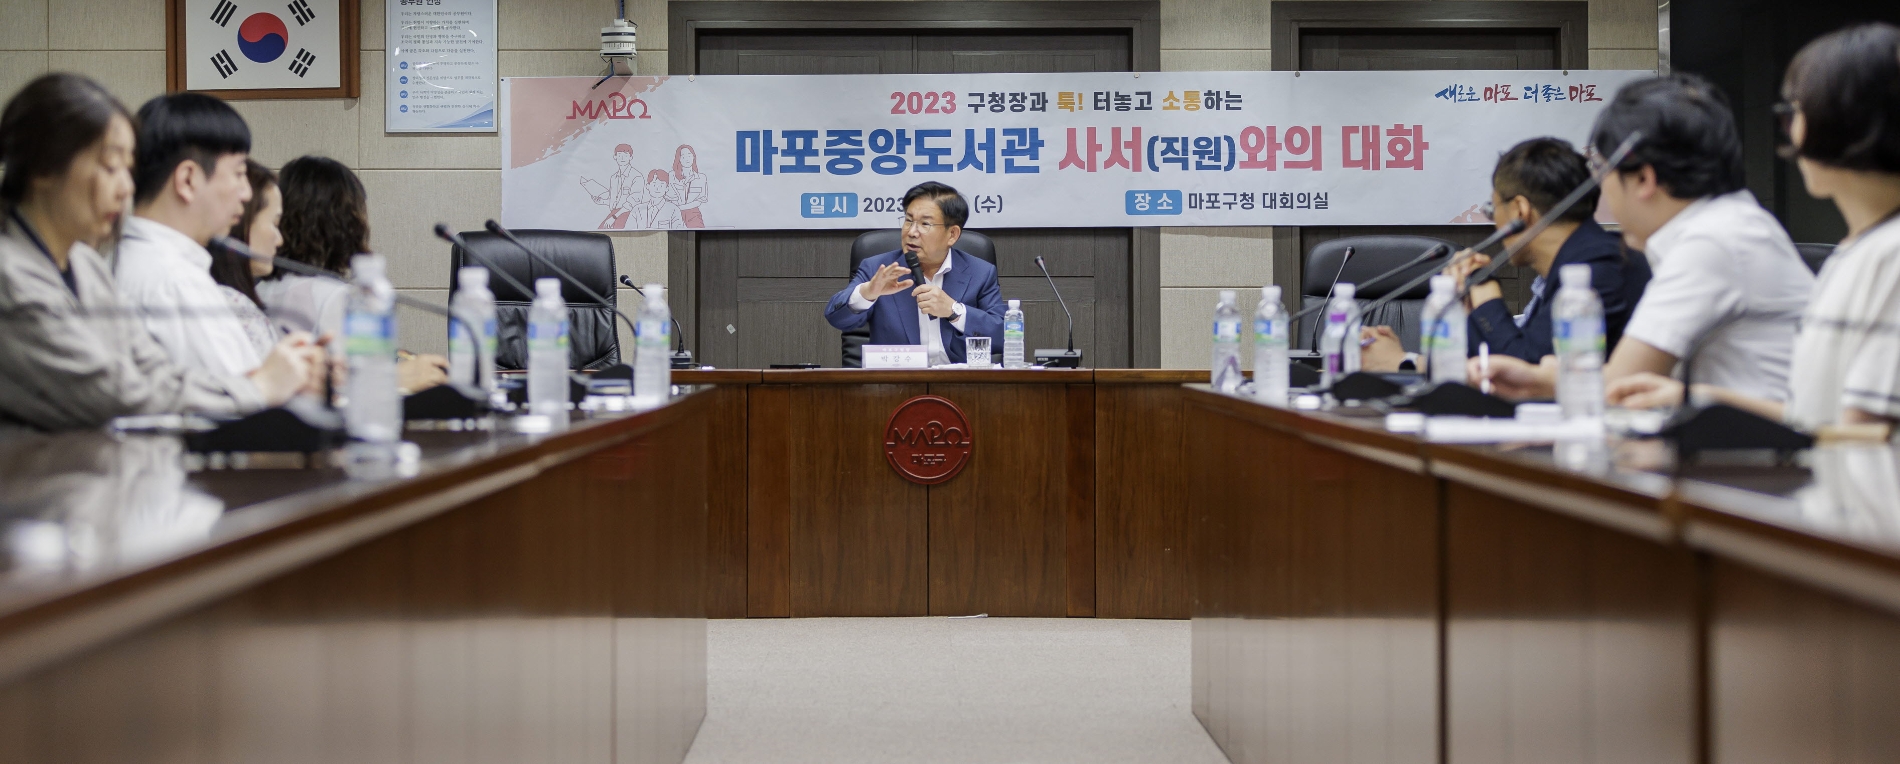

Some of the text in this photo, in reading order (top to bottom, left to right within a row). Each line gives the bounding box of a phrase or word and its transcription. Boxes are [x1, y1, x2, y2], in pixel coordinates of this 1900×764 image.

[566, 92, 652, 119] MAPO
[890, 91, 957, 115] 2023
[967, 91, 1049, 114] 구청장과
[1093, 90, 1153, 112] 터놓고
[1162, 89, 1242, 112] 소통하는
[1434, 83, 1603, 104] 새로운 마포 더 좋은 마포
[735, 123, 1430, 176] 마포중앙도서관 사서(직원)와의 대화
[974, 194, 1004, 214] (수)
[1188, 192, 1255, 211] 마포구청
[1262, 192, 1329, 210] 대회의실
[886, 420, 970, 447] MAPO
